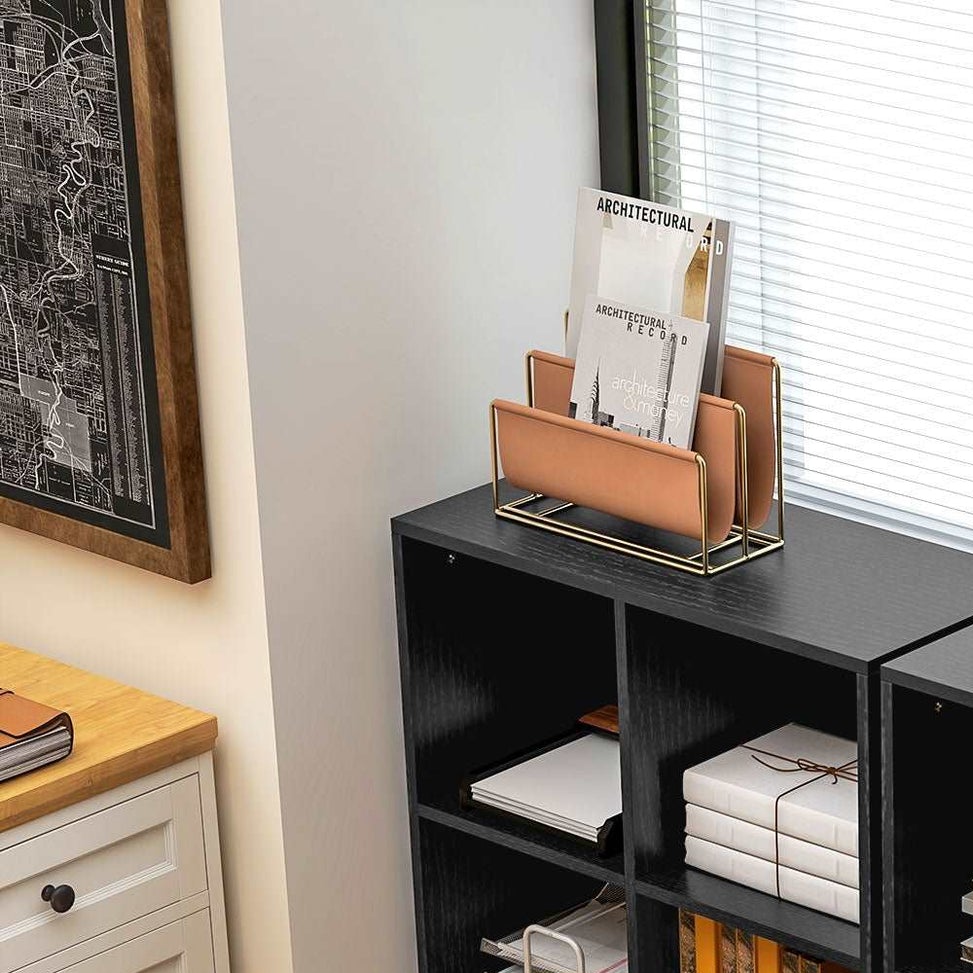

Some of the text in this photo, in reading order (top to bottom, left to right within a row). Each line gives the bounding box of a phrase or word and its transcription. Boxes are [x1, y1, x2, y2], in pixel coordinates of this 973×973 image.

[597, 197, 694, 232] ARCHITECTURAL
[596, 304, 666, 330] ARCHITECTURAL
[627, 322, 687, 345] RECORD
